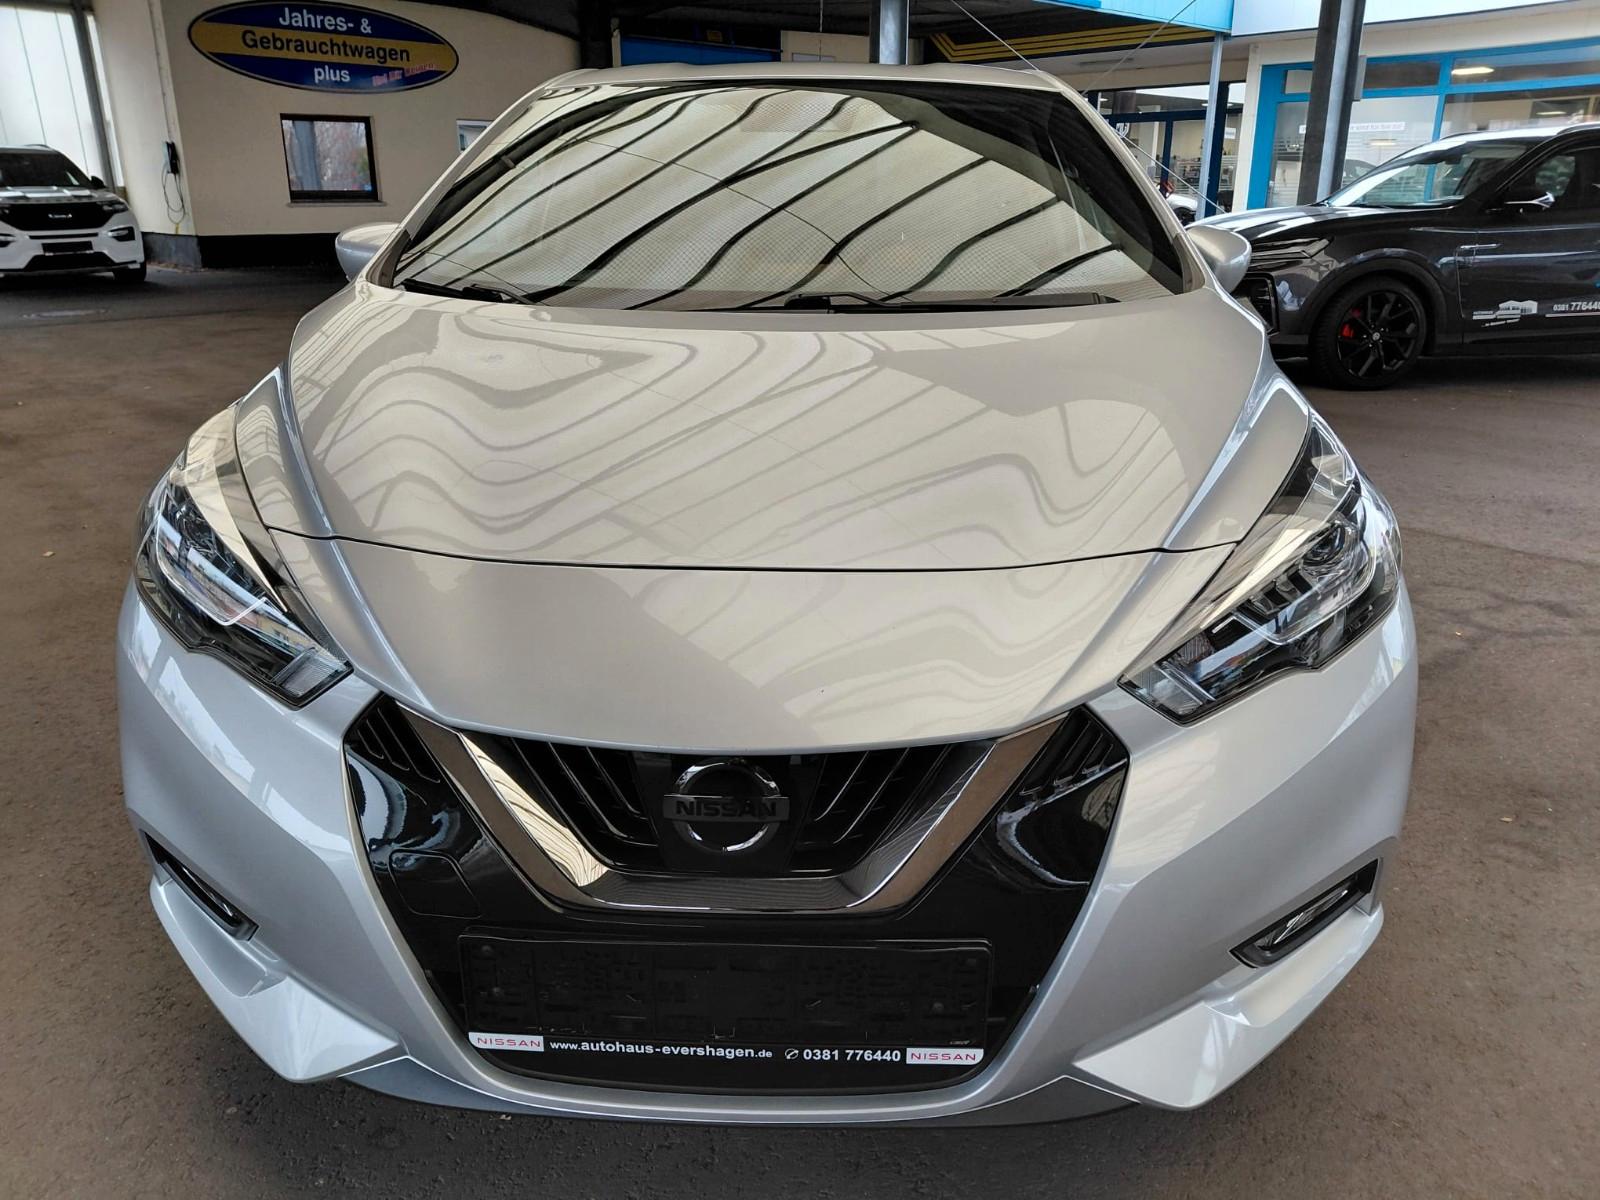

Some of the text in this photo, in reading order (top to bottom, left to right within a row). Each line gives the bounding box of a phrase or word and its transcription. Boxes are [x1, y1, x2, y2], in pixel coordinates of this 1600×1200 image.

[278, 7, 372, 34] Jahres- &
[241, 29, 410, 64] Gebrauchtwagen
[313, 64, 351, 84] plus
[675, 800, 777, 817] NISSAN
[476, 1036, 542, 1048] NISSAN
[549, 1040, 901, 1062] www.autohaus-evershagen.de 0381 776440
[910, 1051, 977, 1062] NISSAN
